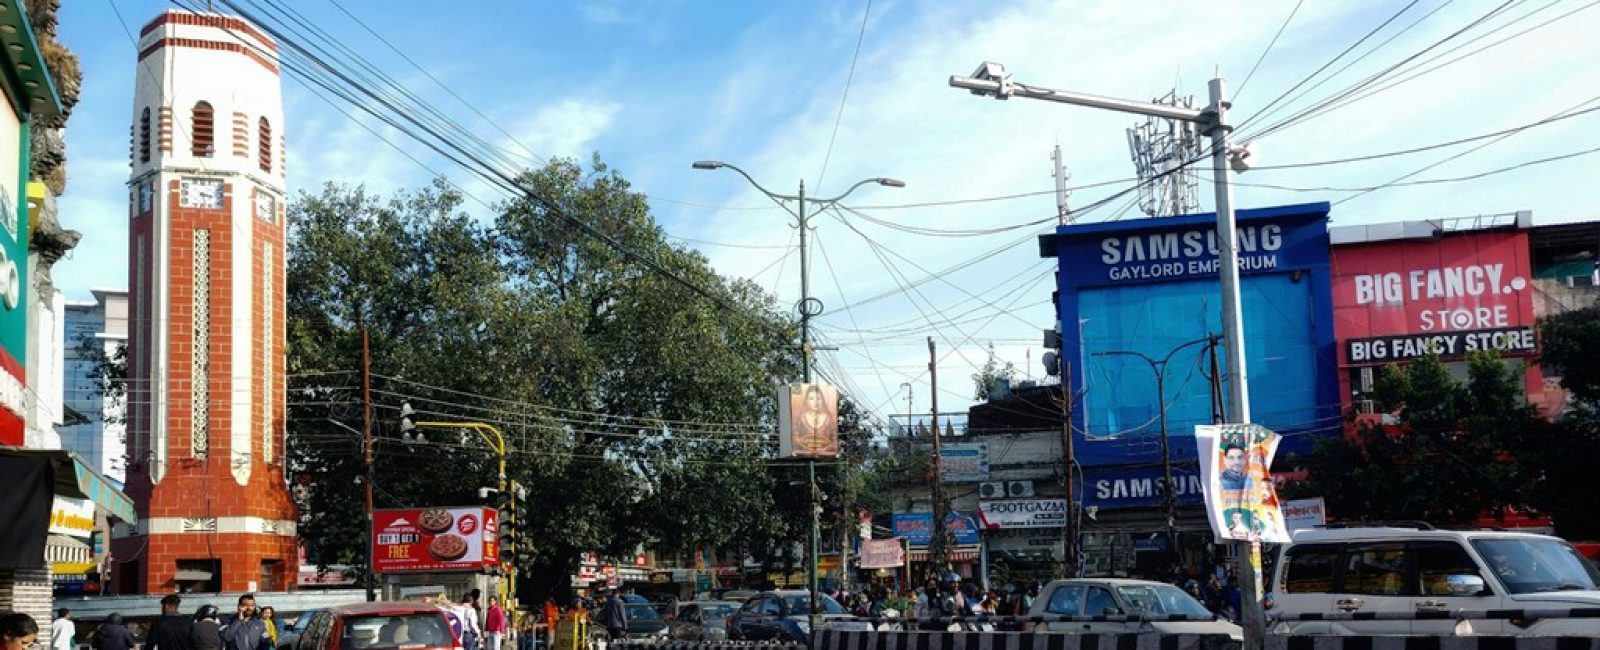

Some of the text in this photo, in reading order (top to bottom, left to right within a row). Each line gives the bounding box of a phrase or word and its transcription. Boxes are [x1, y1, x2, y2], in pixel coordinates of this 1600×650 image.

[1101, 224, 1282, 265] SAMSUNG
[1108, 254, 1278, 281] GAYLORD EMPRIUM
[1355, 272, 1404, 304] BIG
[1420, 305, 1509, 331] STORE
[1351, 329, 1536, 361] BIG FANCY STORE
[1096, 474, 1203, 500] SAMSUN
[388, 545, 410, 558] FREE
